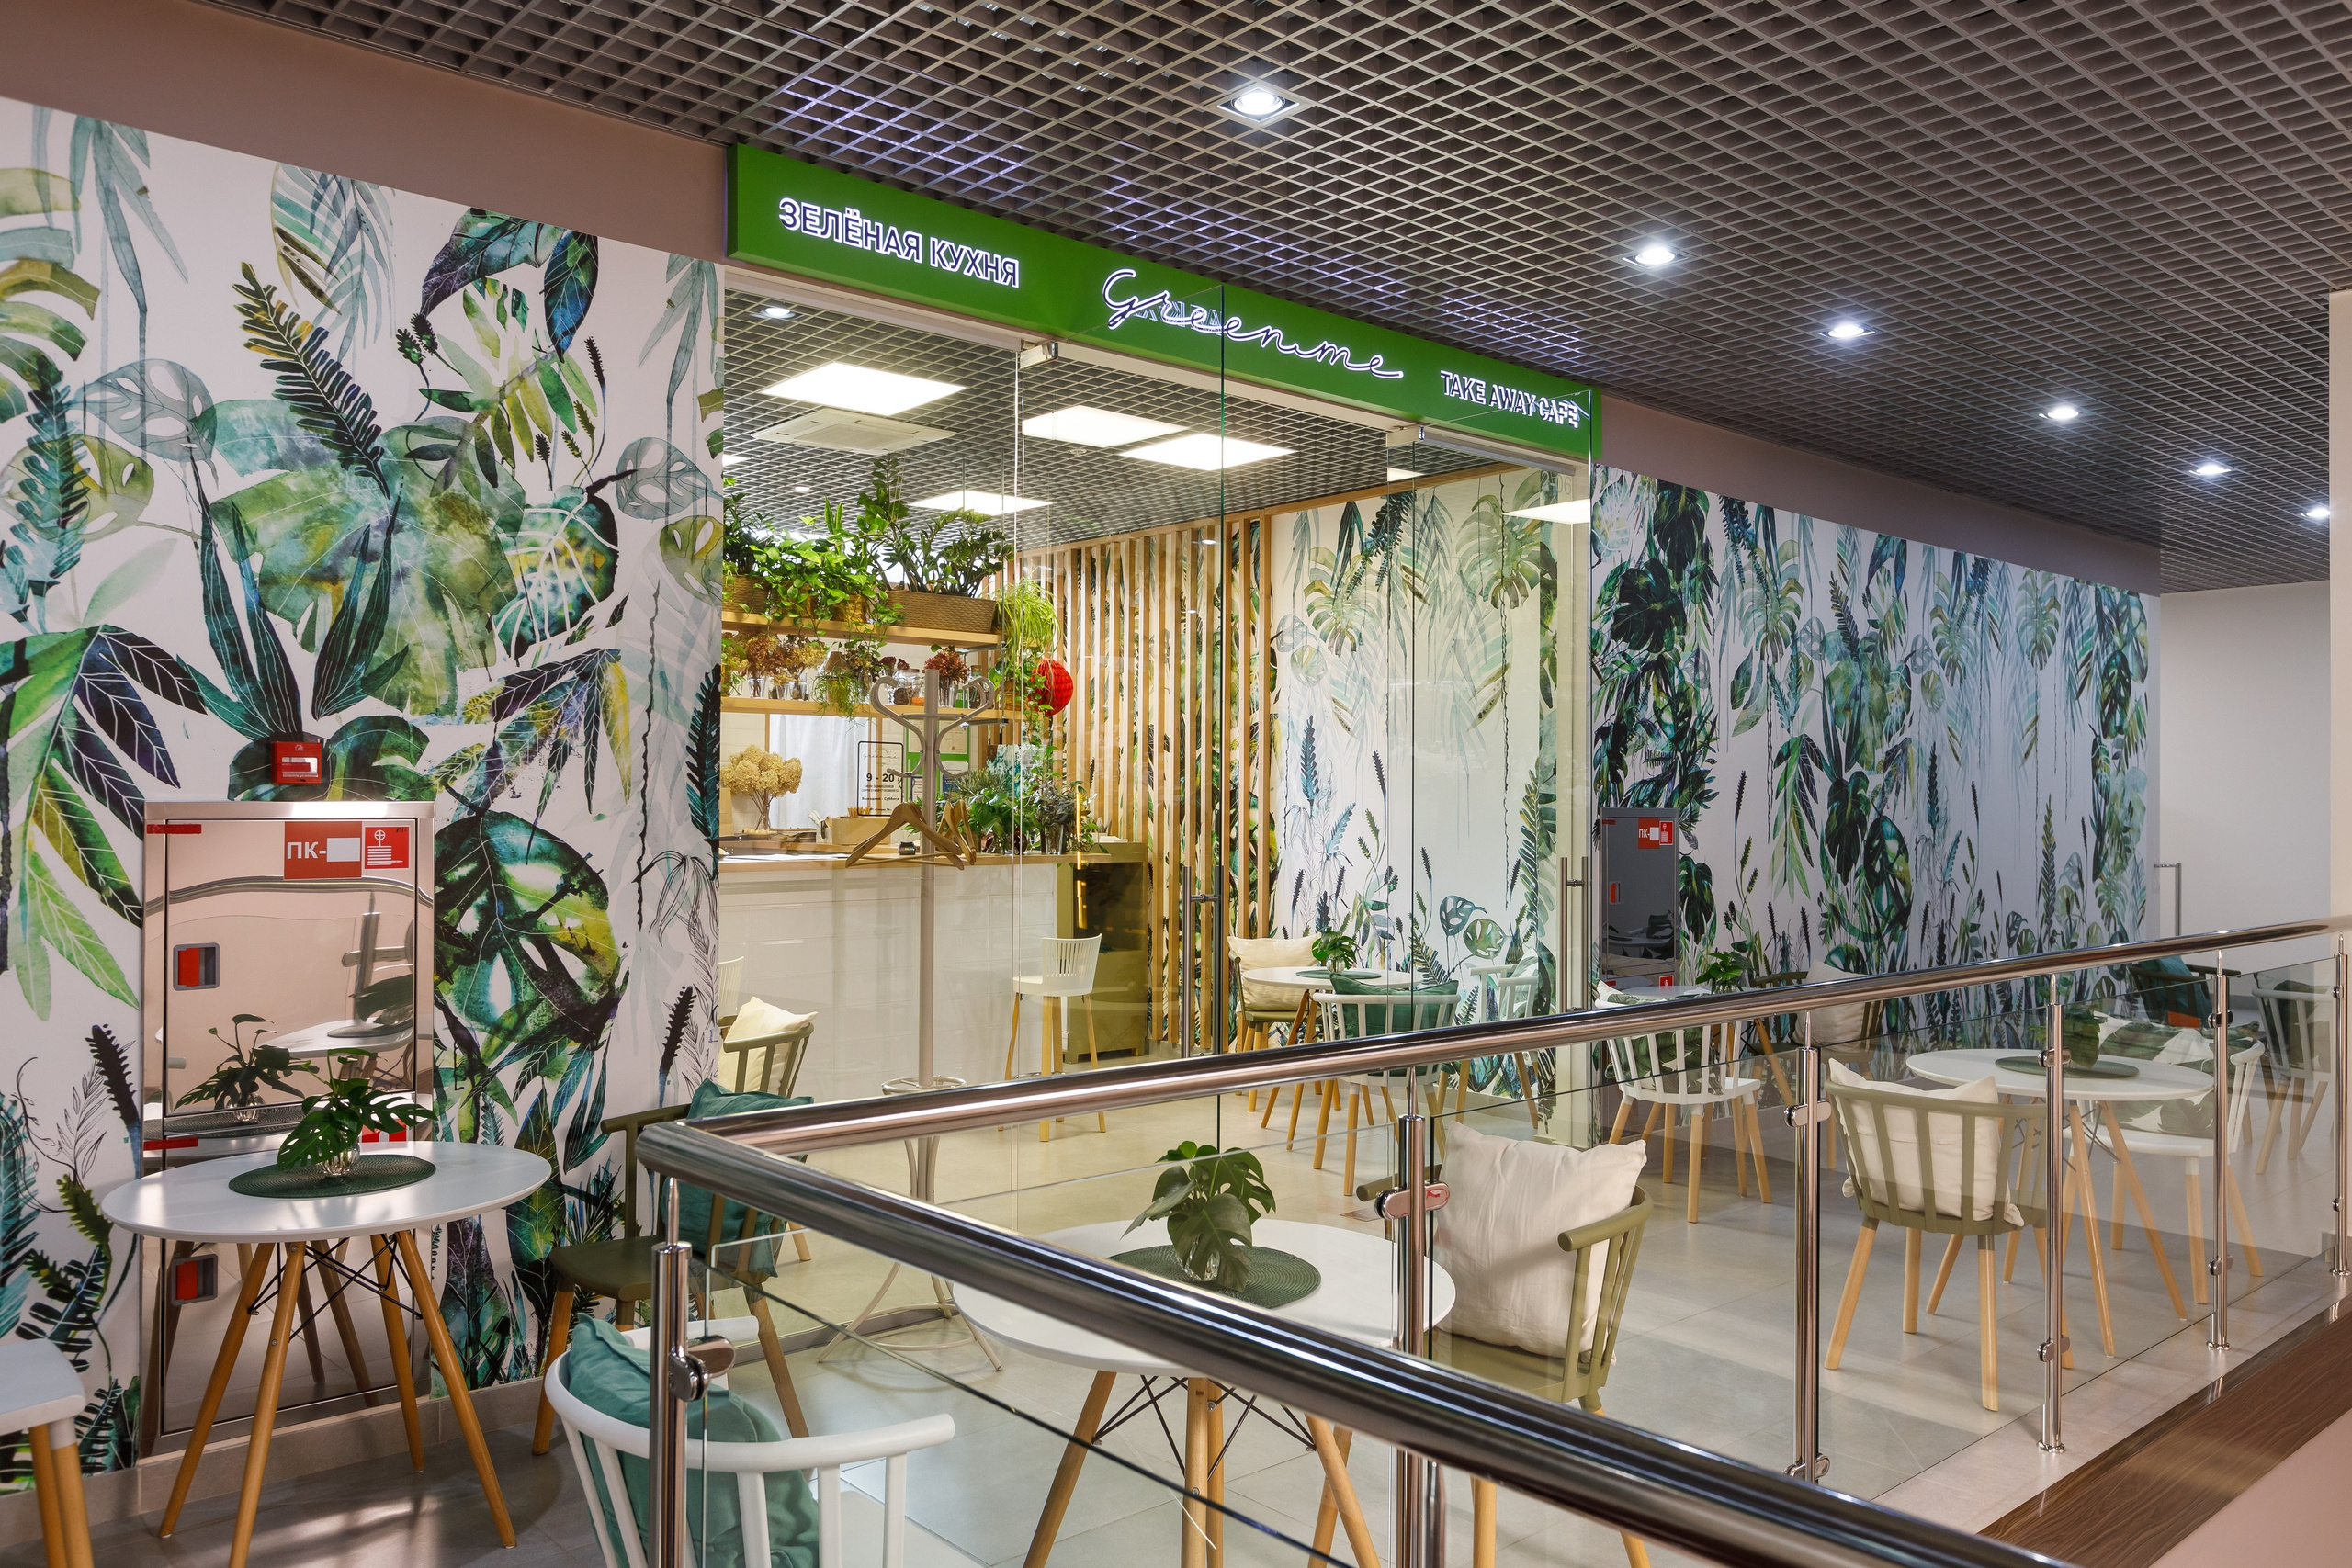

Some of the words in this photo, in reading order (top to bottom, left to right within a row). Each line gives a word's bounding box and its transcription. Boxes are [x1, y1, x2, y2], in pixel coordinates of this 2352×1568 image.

[778, 197, 922, 264] ЗЕЛЁНАЯ
[930, 236, 1021, 288] КУХНЯ
[1440, 369, 1487, 405] TAKE
[1488, 384, 1537, 417] AWAY
[866, 773, 873, 782] 9
[882, 773, 895, 783] 20
